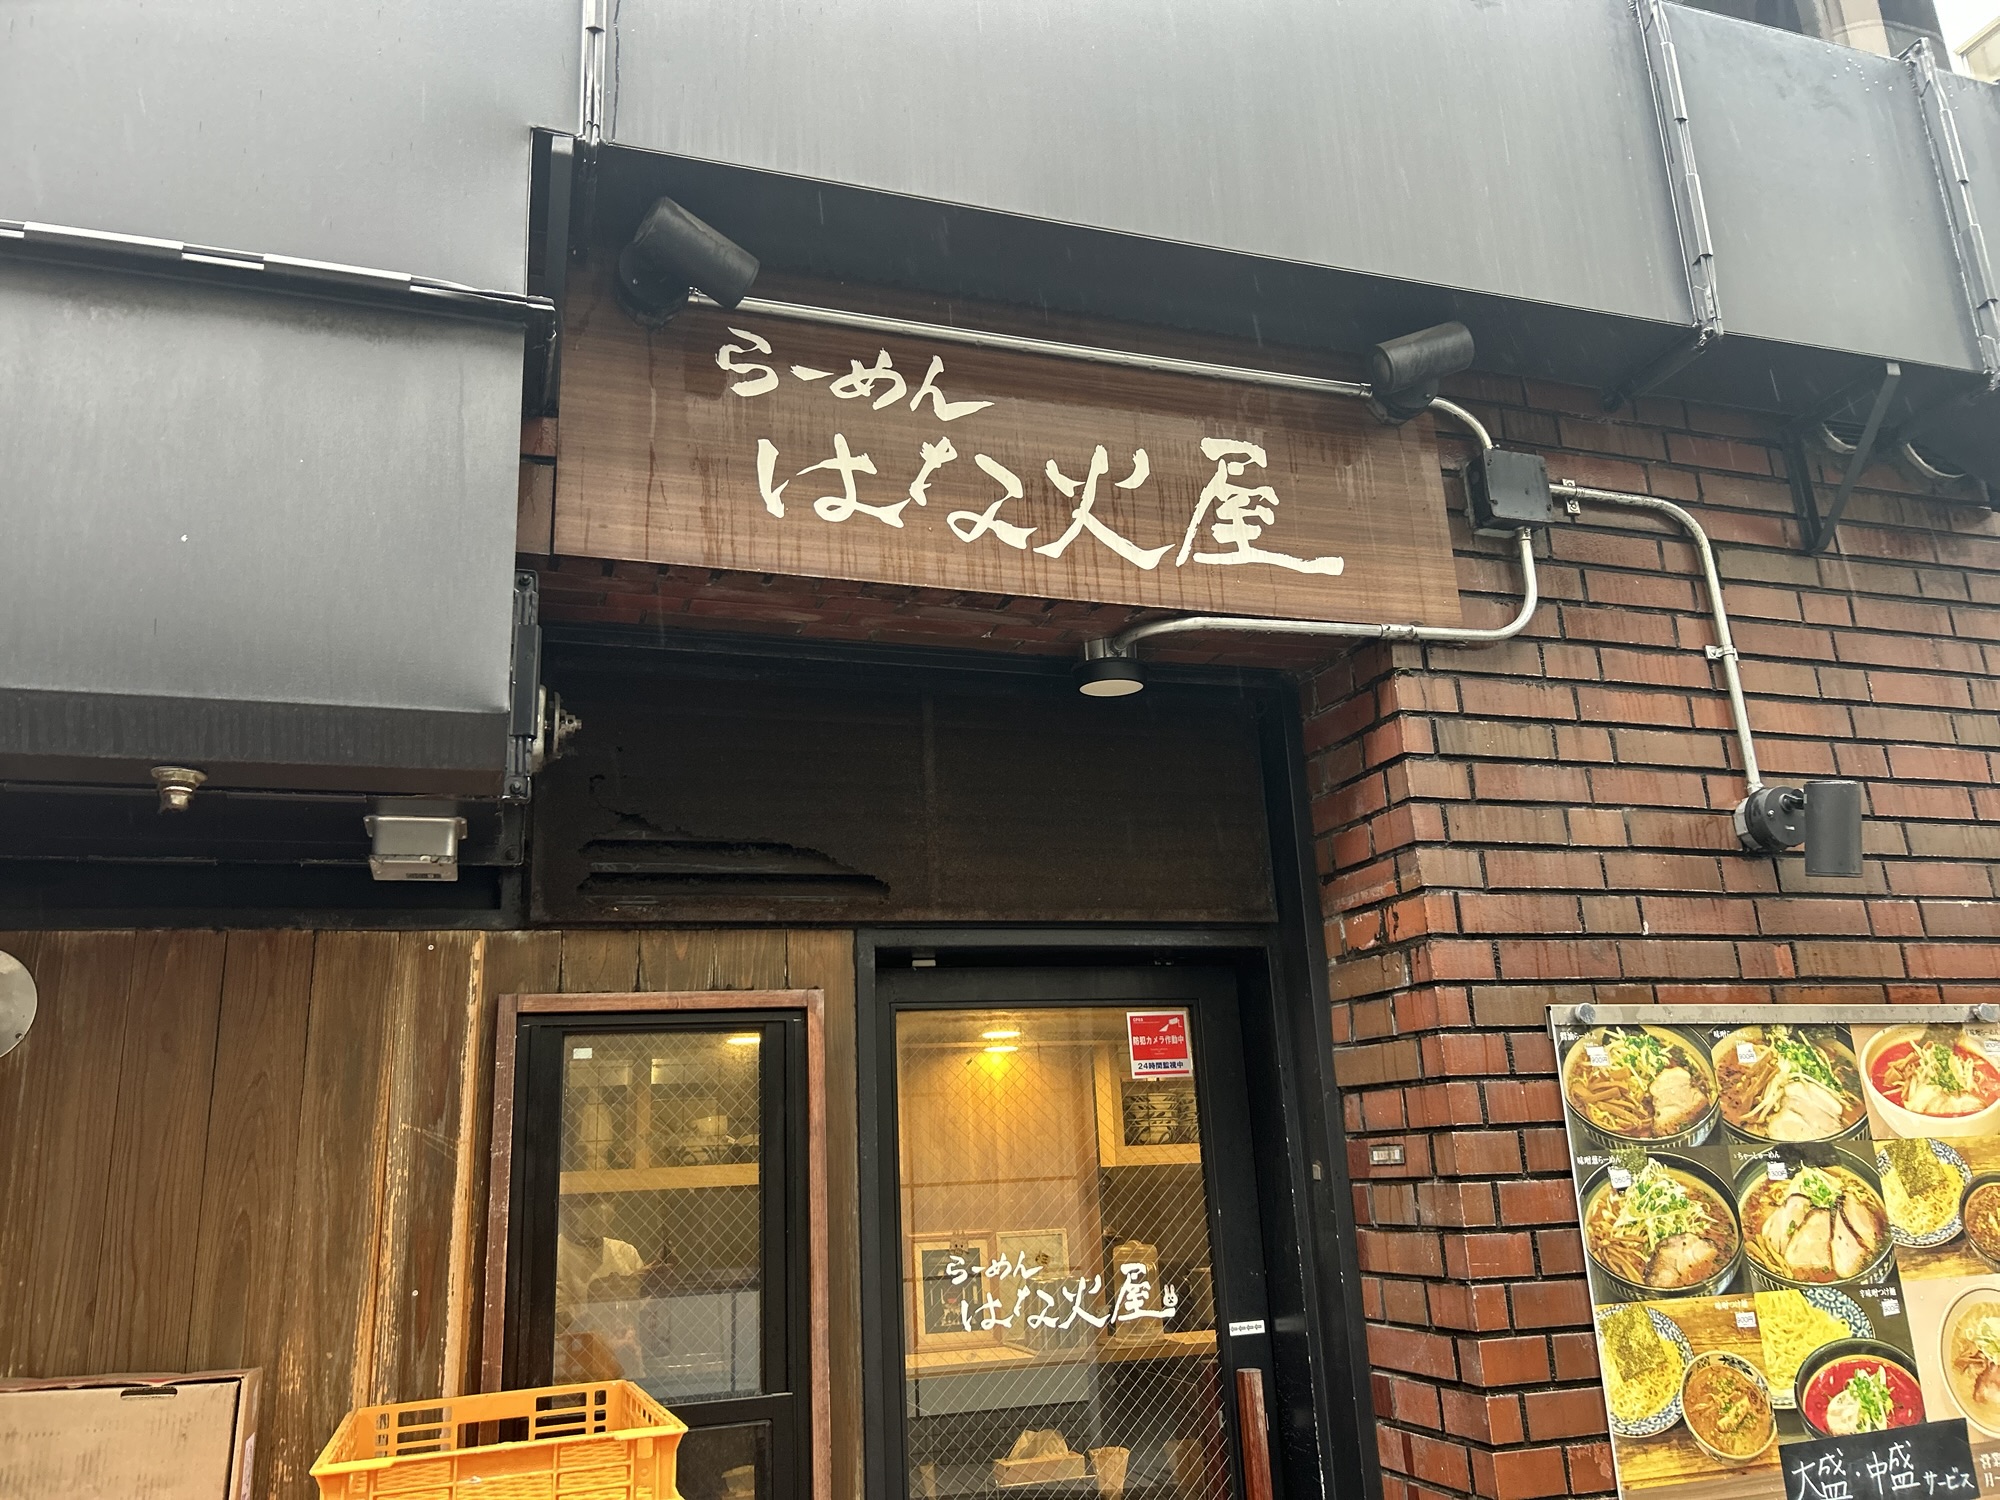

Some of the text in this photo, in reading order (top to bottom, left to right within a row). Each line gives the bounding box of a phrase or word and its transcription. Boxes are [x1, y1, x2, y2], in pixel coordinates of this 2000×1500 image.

[715, 326, 994, 422] らーめん
[756, 433, 1344, 576] はな火屋
[1133, 1034, 1185, 1046] 防犯カメラ作動中
[1137, 1060, 1184, 1071] 24時間監視中
[946, 1250, 1043, 1285] らーめん
[960, 1263, 1175, 1332] はな火屋
